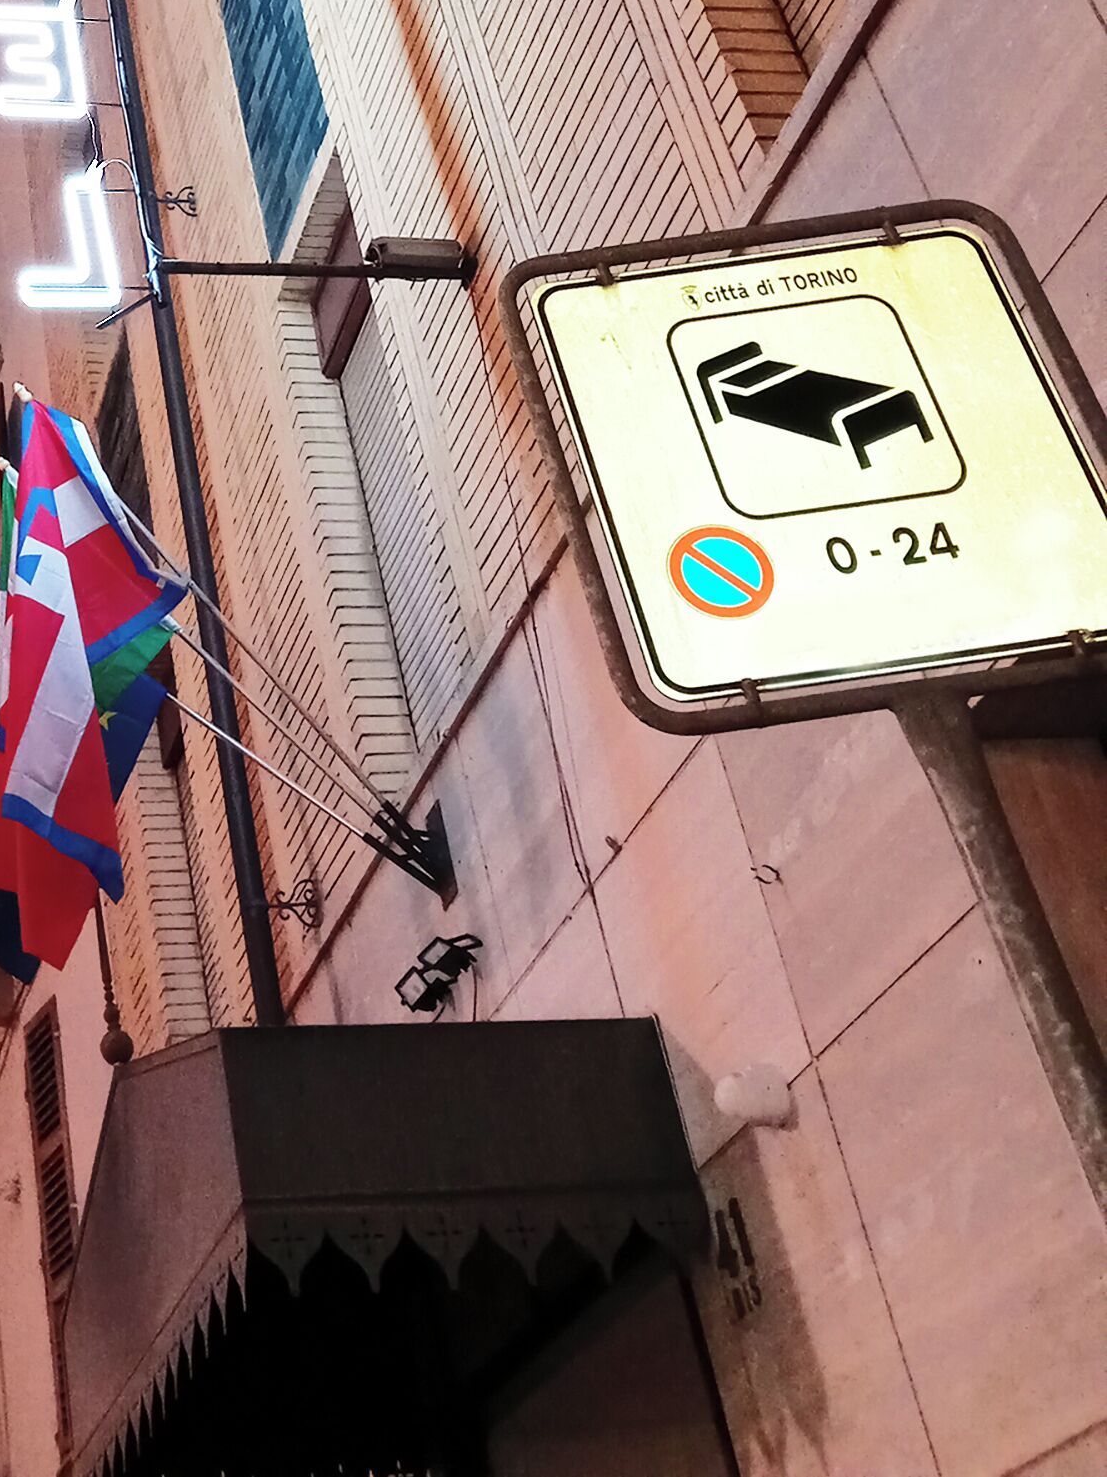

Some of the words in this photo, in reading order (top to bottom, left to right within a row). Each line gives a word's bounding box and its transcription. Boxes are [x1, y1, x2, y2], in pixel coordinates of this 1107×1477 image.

[704, 282, 750, 304] città
[756, 278, 776, 296] di
[779, 267, 859, 292] TORINO
[715, 1197, 756, 1278] 41
